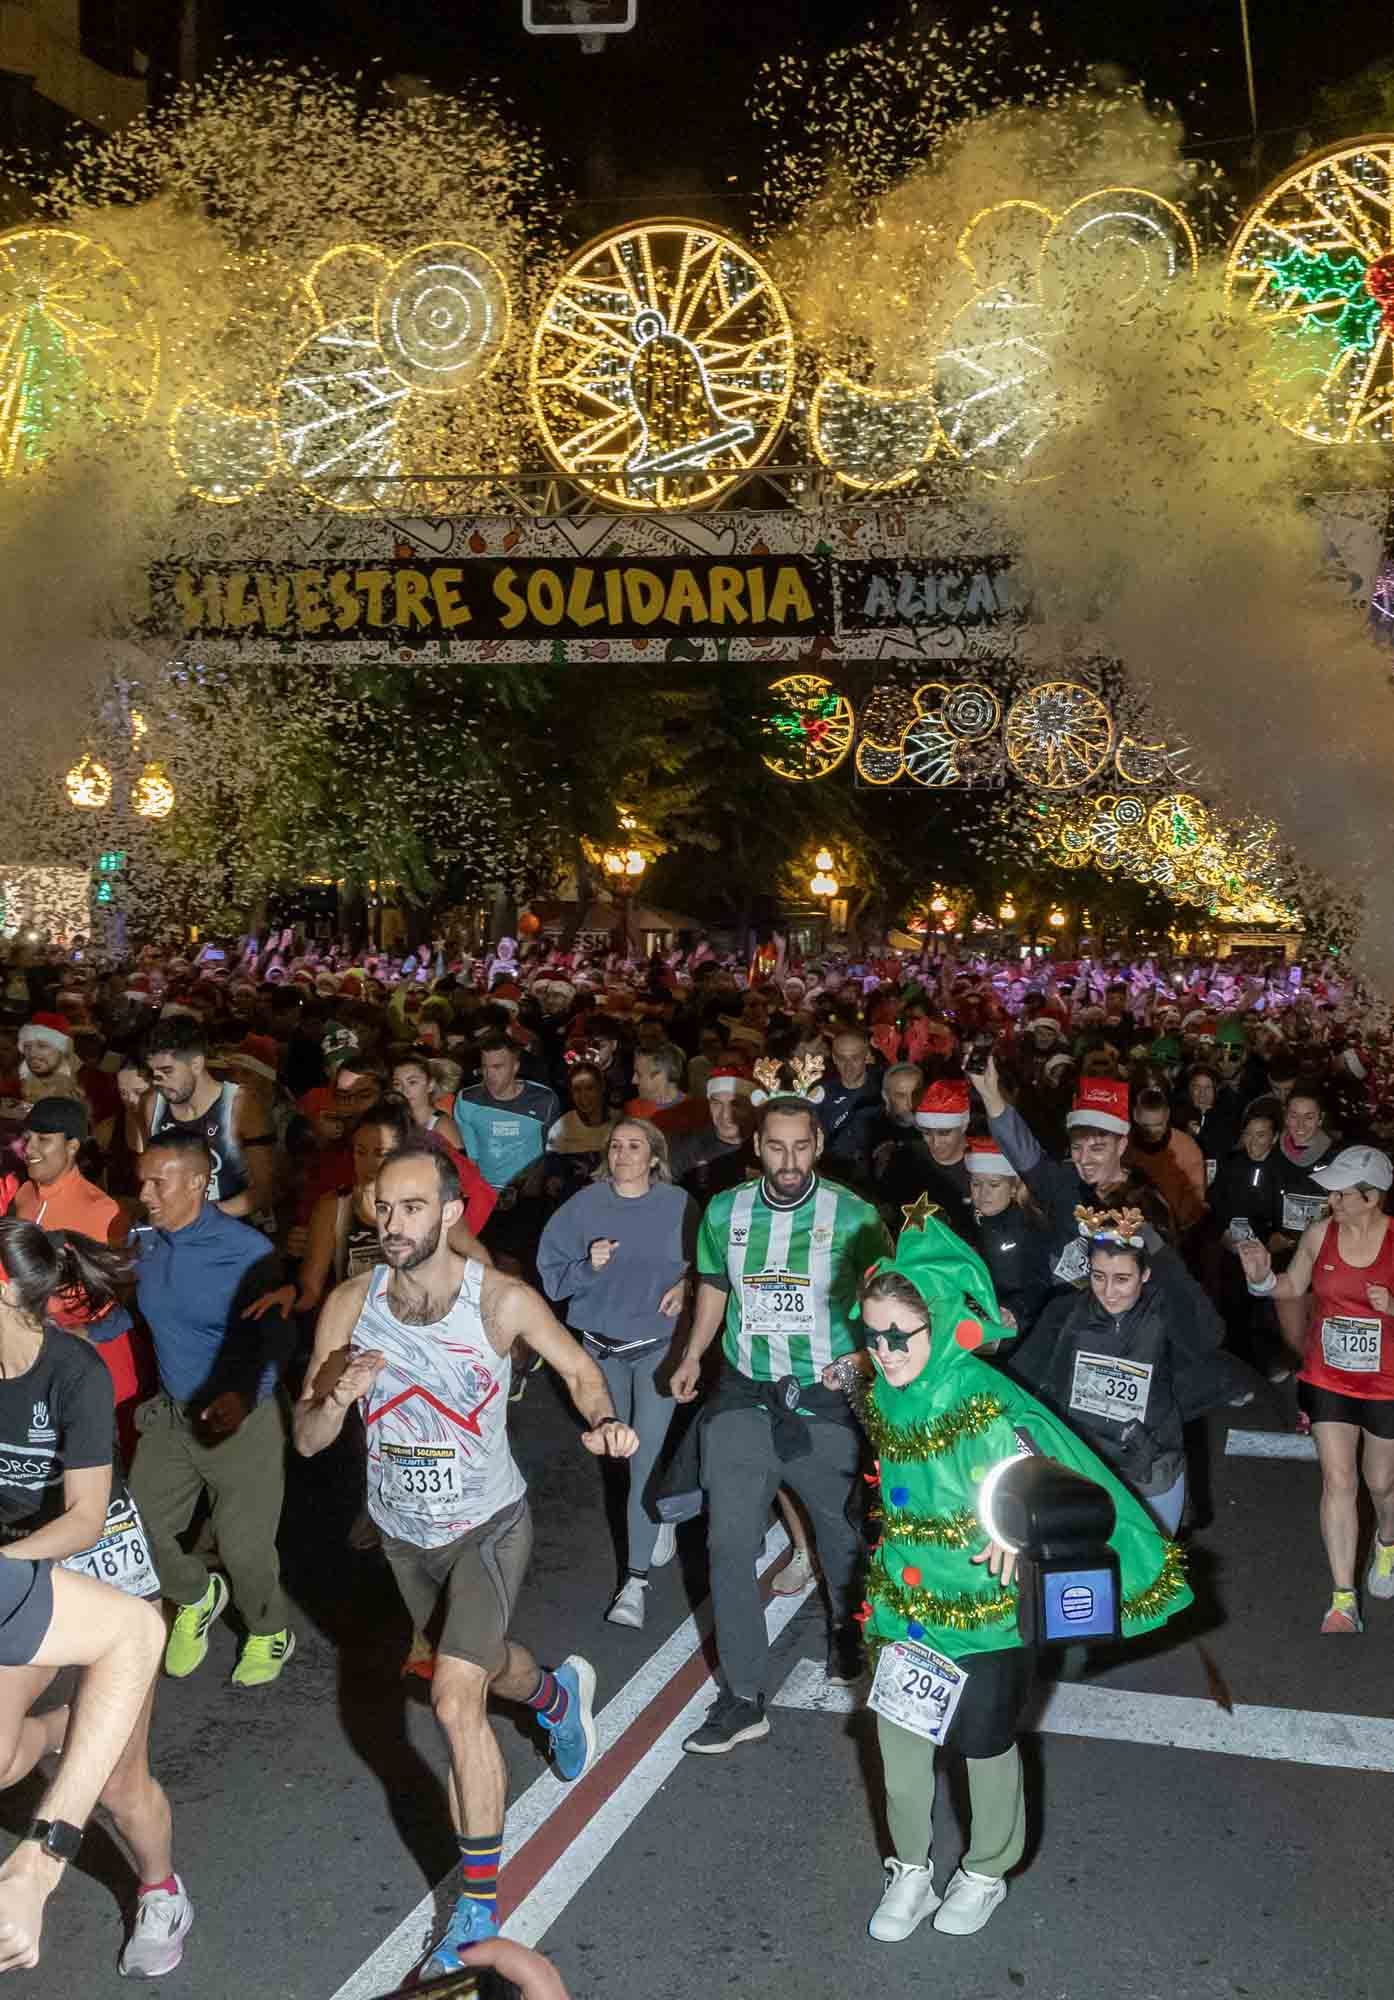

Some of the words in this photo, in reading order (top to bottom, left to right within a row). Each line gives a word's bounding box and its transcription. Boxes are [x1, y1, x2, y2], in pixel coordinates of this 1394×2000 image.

[175, 567, 473, 631] SILVESTRE
[493, 566, 814, 629] SOLIDARIA
[774, 1293, 804, 1312] 328
[1341, 1335, 1377, 1353] 1205
[1105, 1379, 1138, 1401] 329
[402, 1467, 453, 1493] 3331
[87, 1539, 144, 1579] 1878
